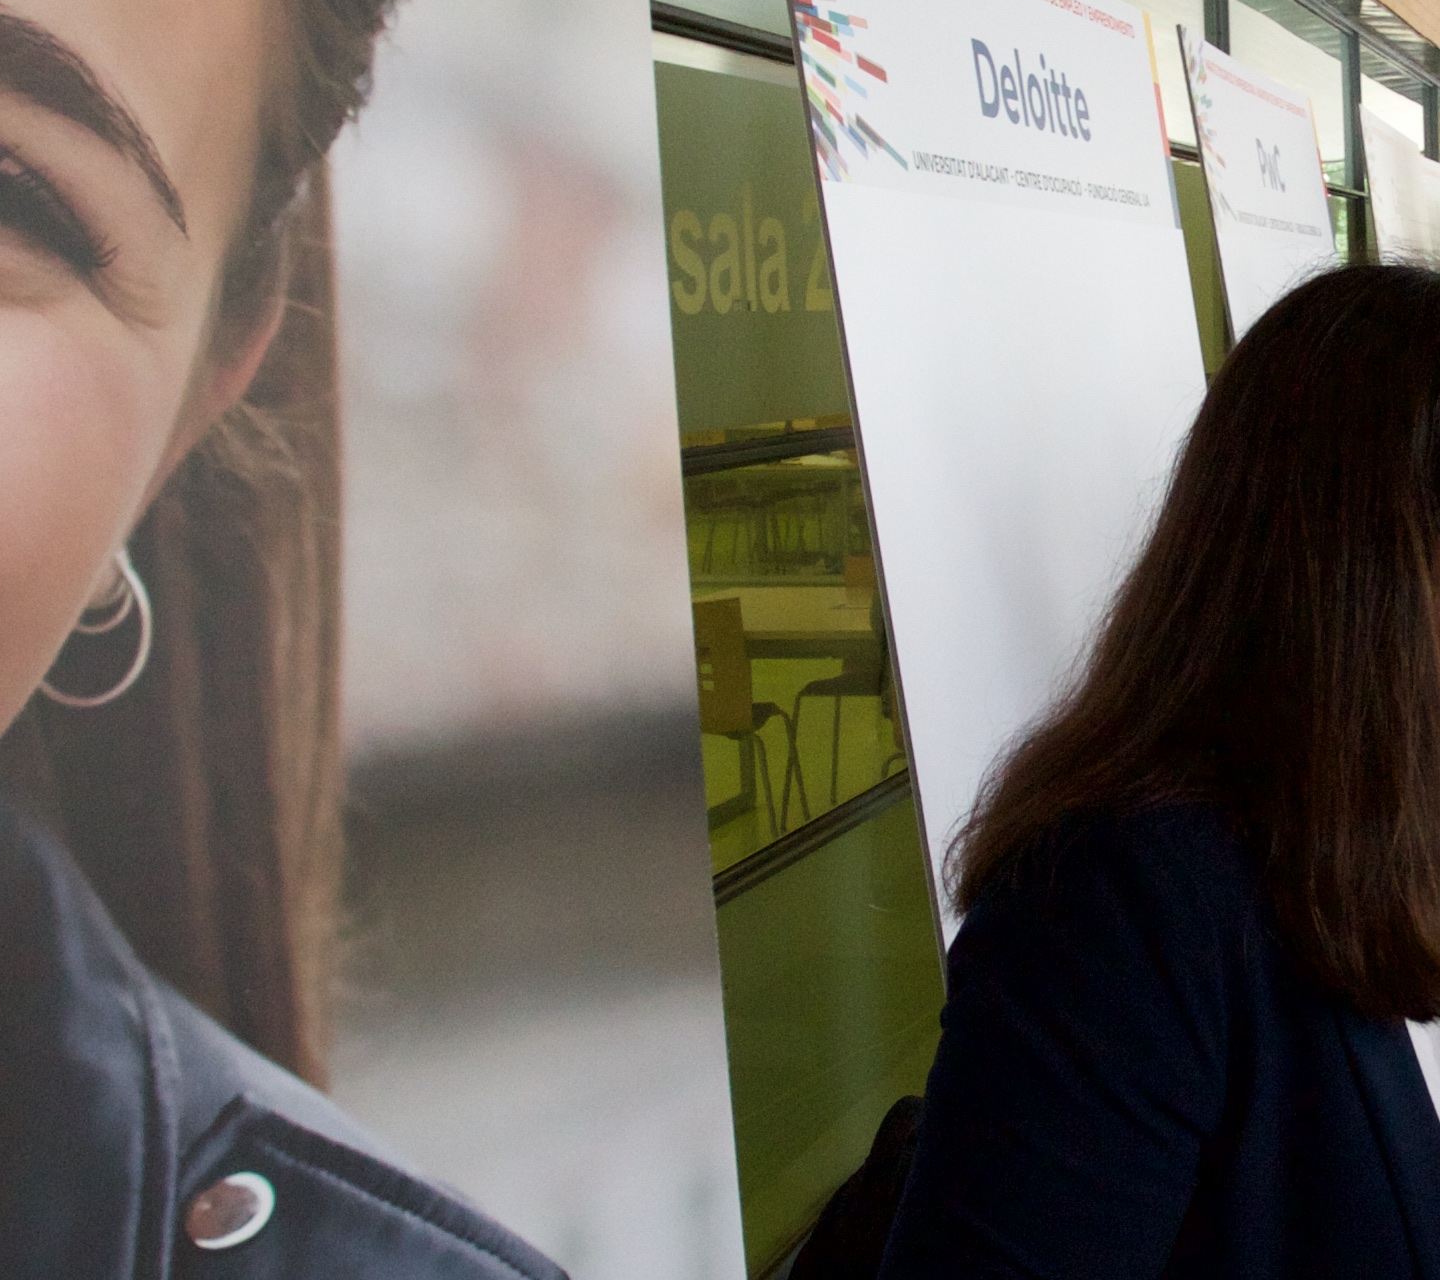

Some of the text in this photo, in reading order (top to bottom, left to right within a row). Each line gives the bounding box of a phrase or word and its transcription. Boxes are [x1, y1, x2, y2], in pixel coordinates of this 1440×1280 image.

[971, 37, 1091, 142] Deloitte
[912, 150, 967, 178] UNIVERSITAT
[671, 182, 791, 315] sala
